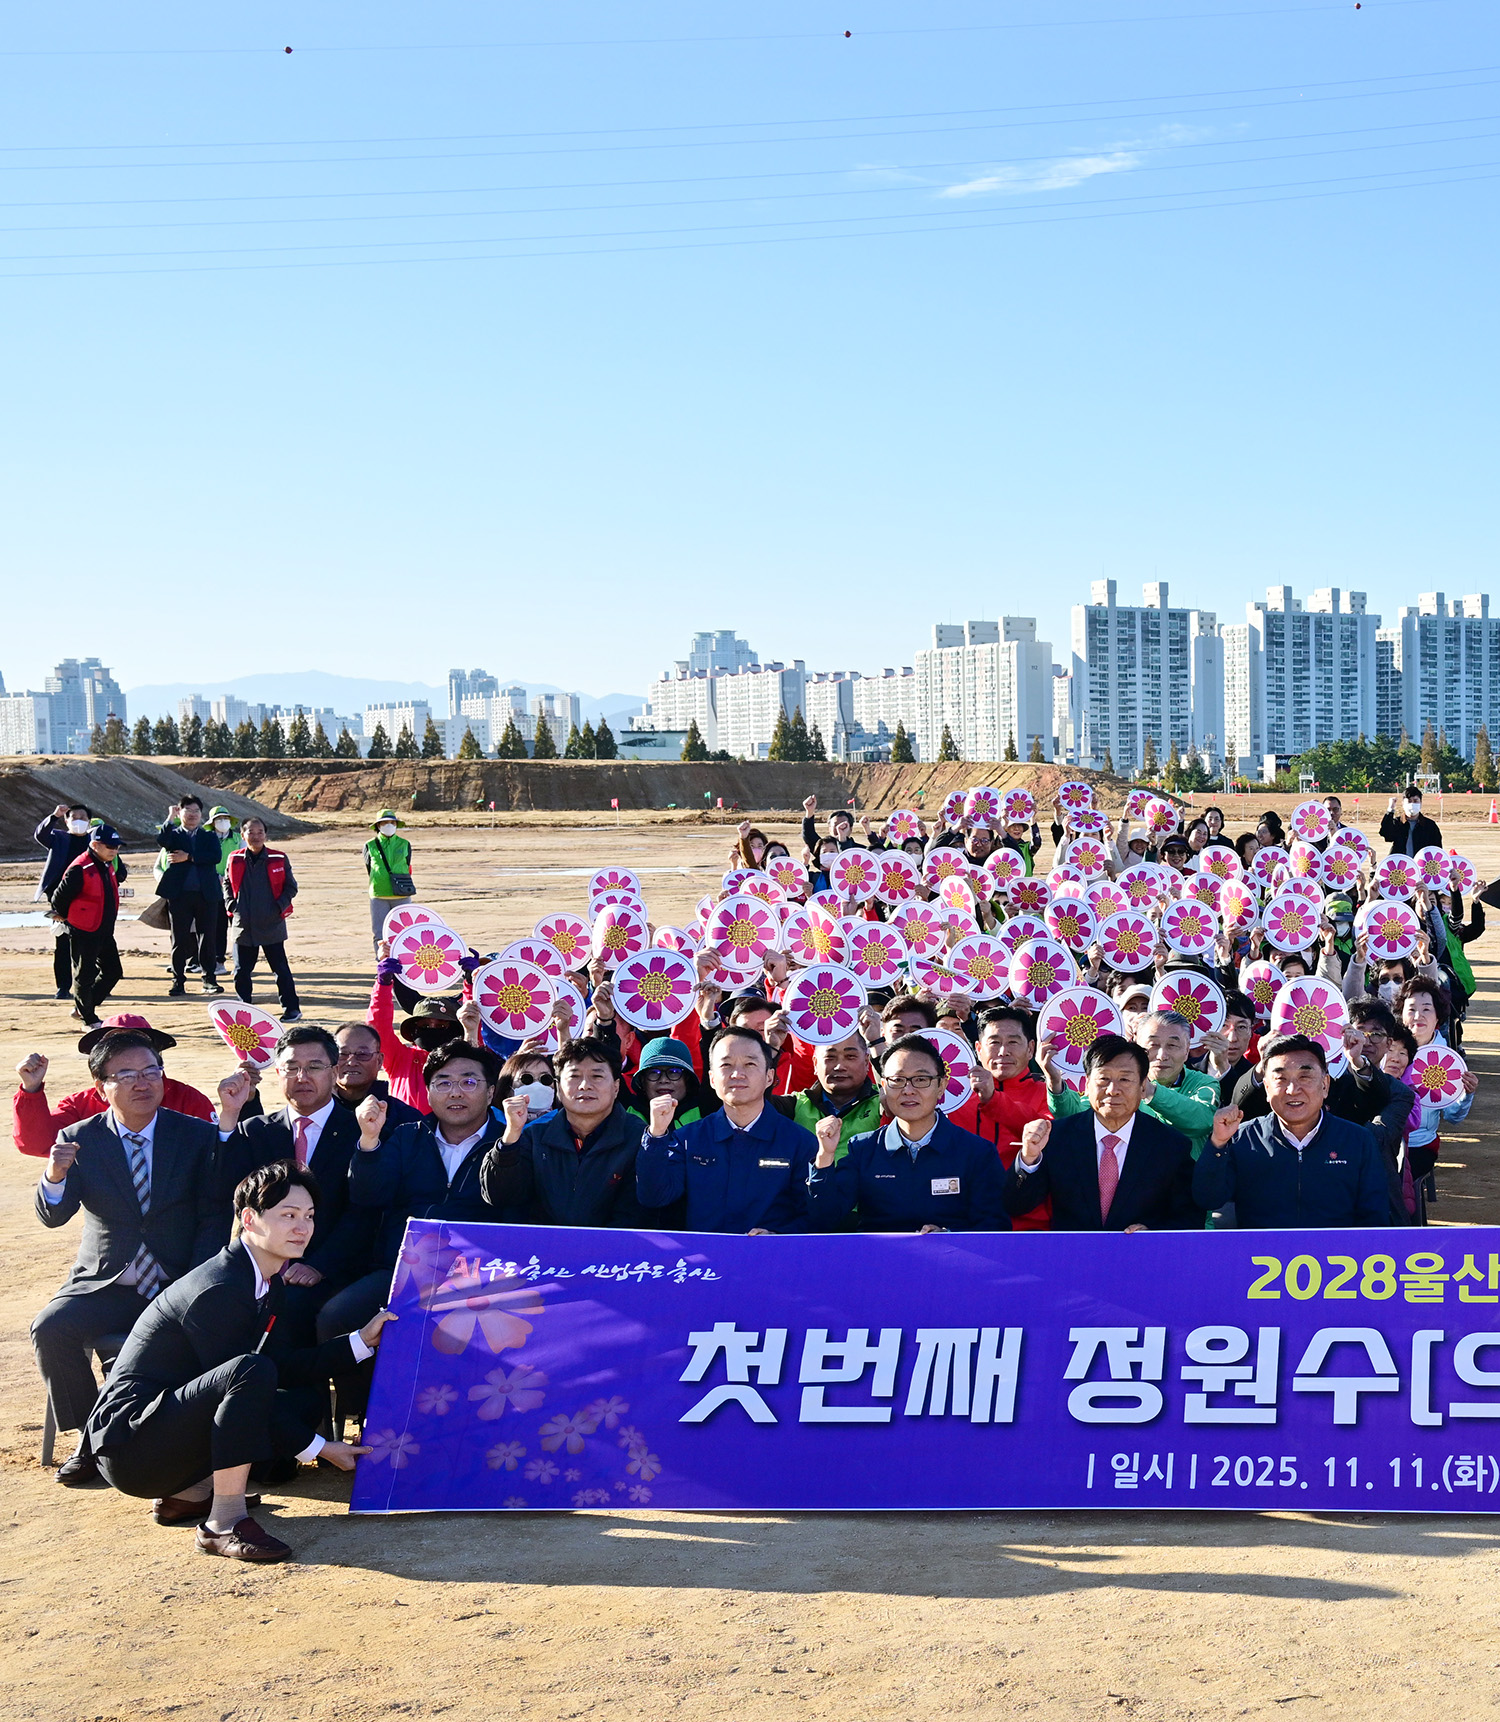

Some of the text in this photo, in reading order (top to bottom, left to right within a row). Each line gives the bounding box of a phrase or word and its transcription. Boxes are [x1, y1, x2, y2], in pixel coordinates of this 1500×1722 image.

[679, 1322, 1023, 1422] 첫번째
[1111, 1453, 1173, 1489] 일시
[1212, 1456, 1308, 1490] 2025.
[1324, 1456, 1374, 1490] 11.
